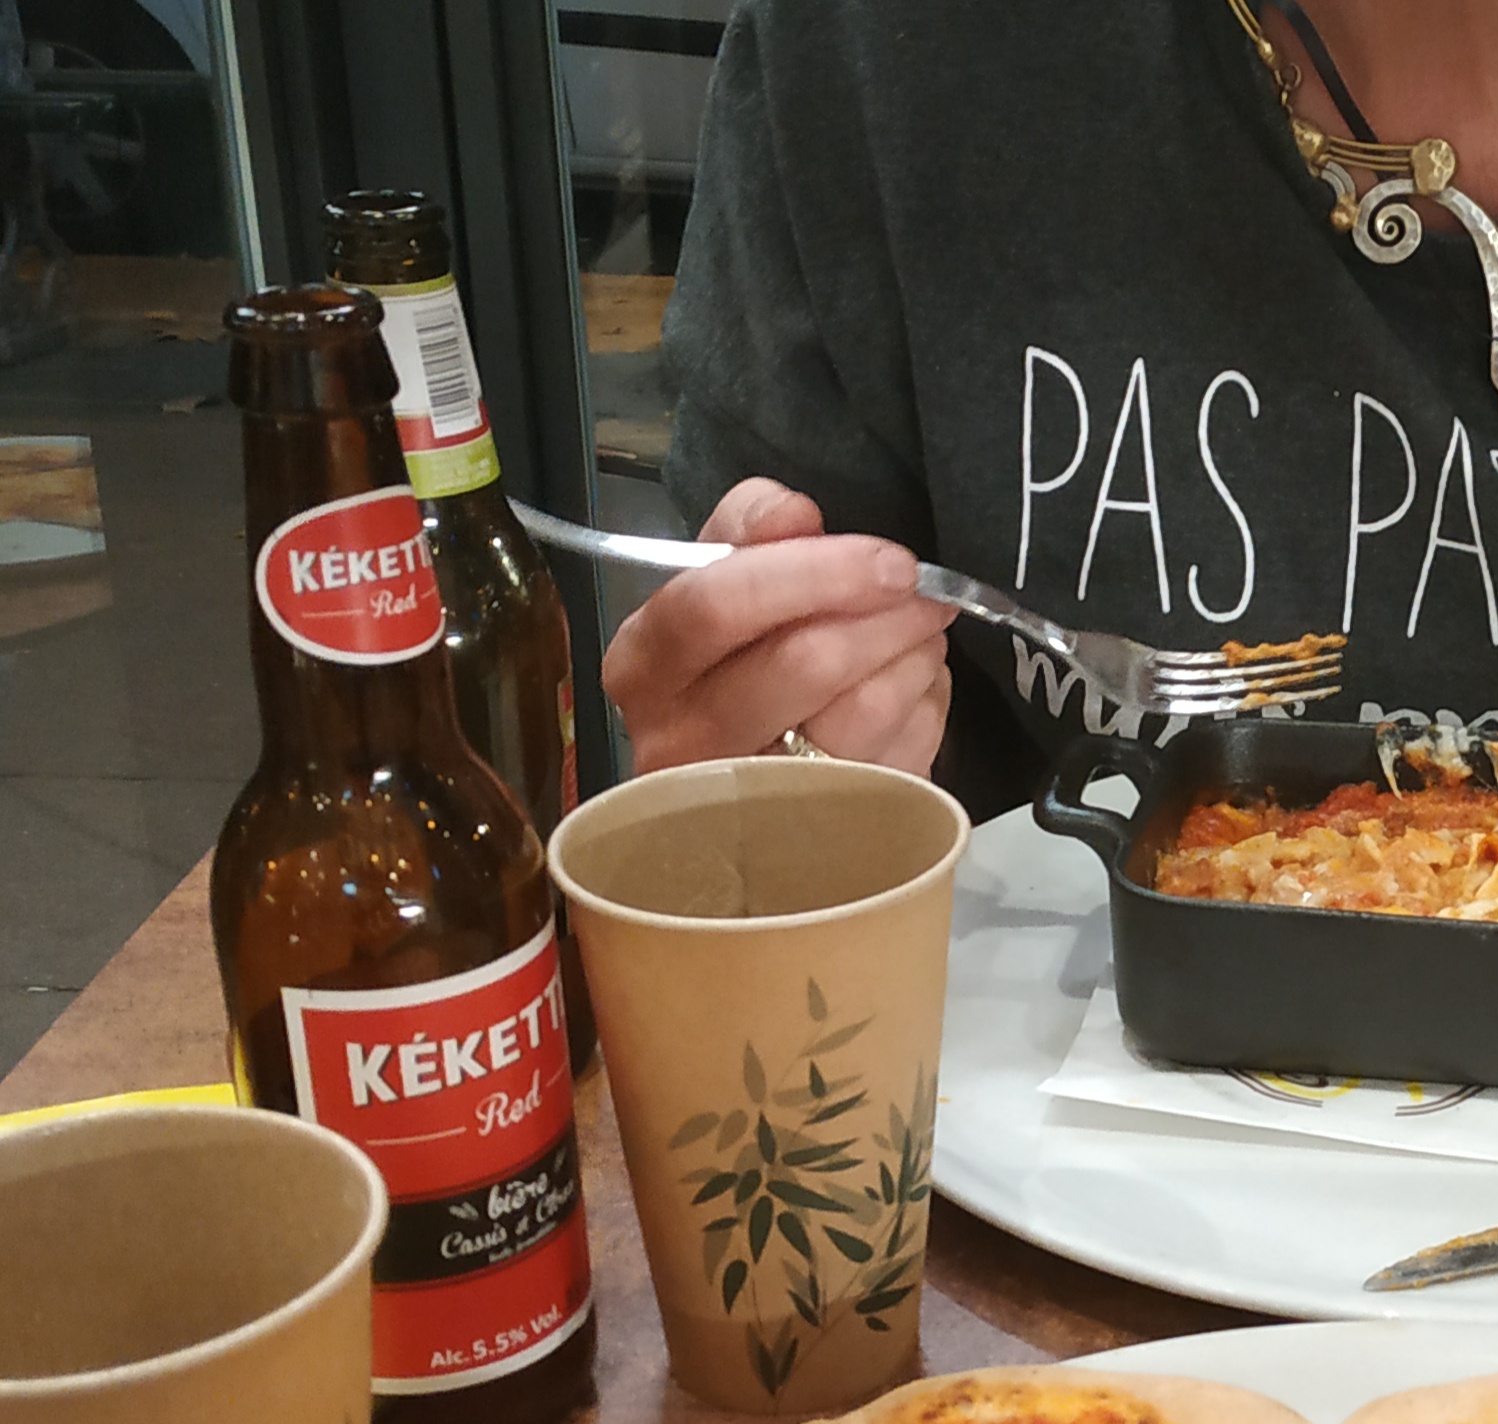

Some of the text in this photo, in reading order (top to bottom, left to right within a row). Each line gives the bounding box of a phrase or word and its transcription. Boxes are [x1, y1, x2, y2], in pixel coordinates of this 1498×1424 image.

[1014, 345, 1261, 624] PAS
[288, 531, 433, 595] KÉKETT
[370, 582, 419, 619] Red
[345, 974, 564, 1107] KÉKETT
[474, 1068, 543, 1137] Red
[430, 1348, 470, 1369] Alc.
[472, 1325, 529, 1361] 5.5%
